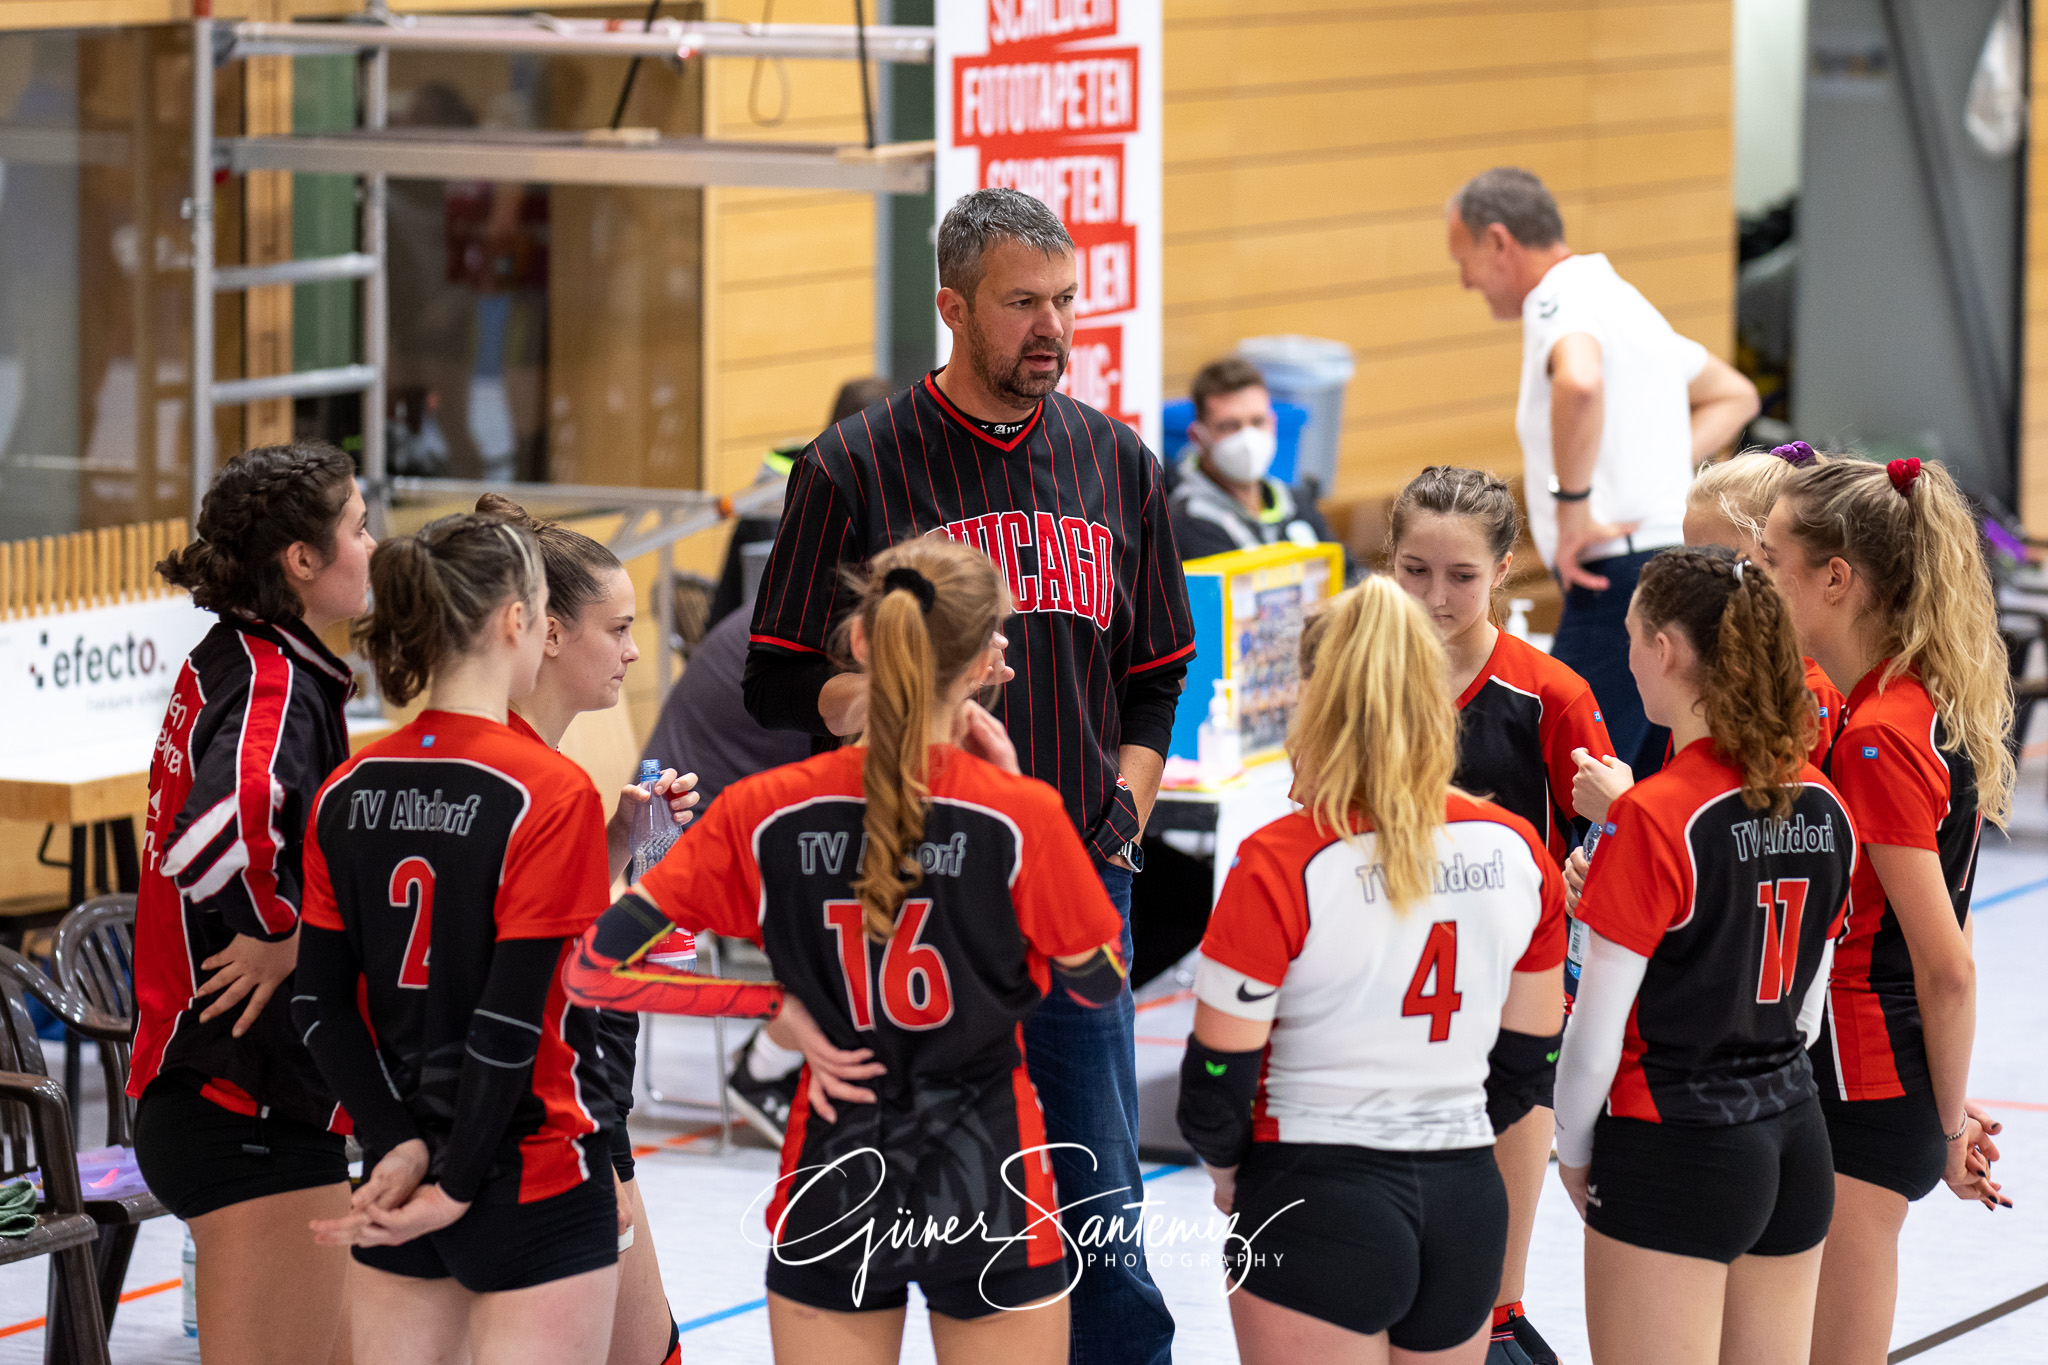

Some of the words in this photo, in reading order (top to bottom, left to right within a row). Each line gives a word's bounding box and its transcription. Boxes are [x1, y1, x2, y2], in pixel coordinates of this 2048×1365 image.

[962, 58, 1134, 137] FOTOTAPETEN
[924, 510, 1115, 631] ICAGO
[347, 789, 387, 831] TV
[390, 788, 482, 837] Altdorf
[797, 831, 850, 875] TV
[1731, 818, 1761, 862] TV
[1763, 812, 1836, 856] Altdorf
[388, 855, 437, 990] 2
[822, 897, 955, 1033] 16
[1400, 918, 1463, 1044] 4
[1755, 877, 1810, 1005] 11
